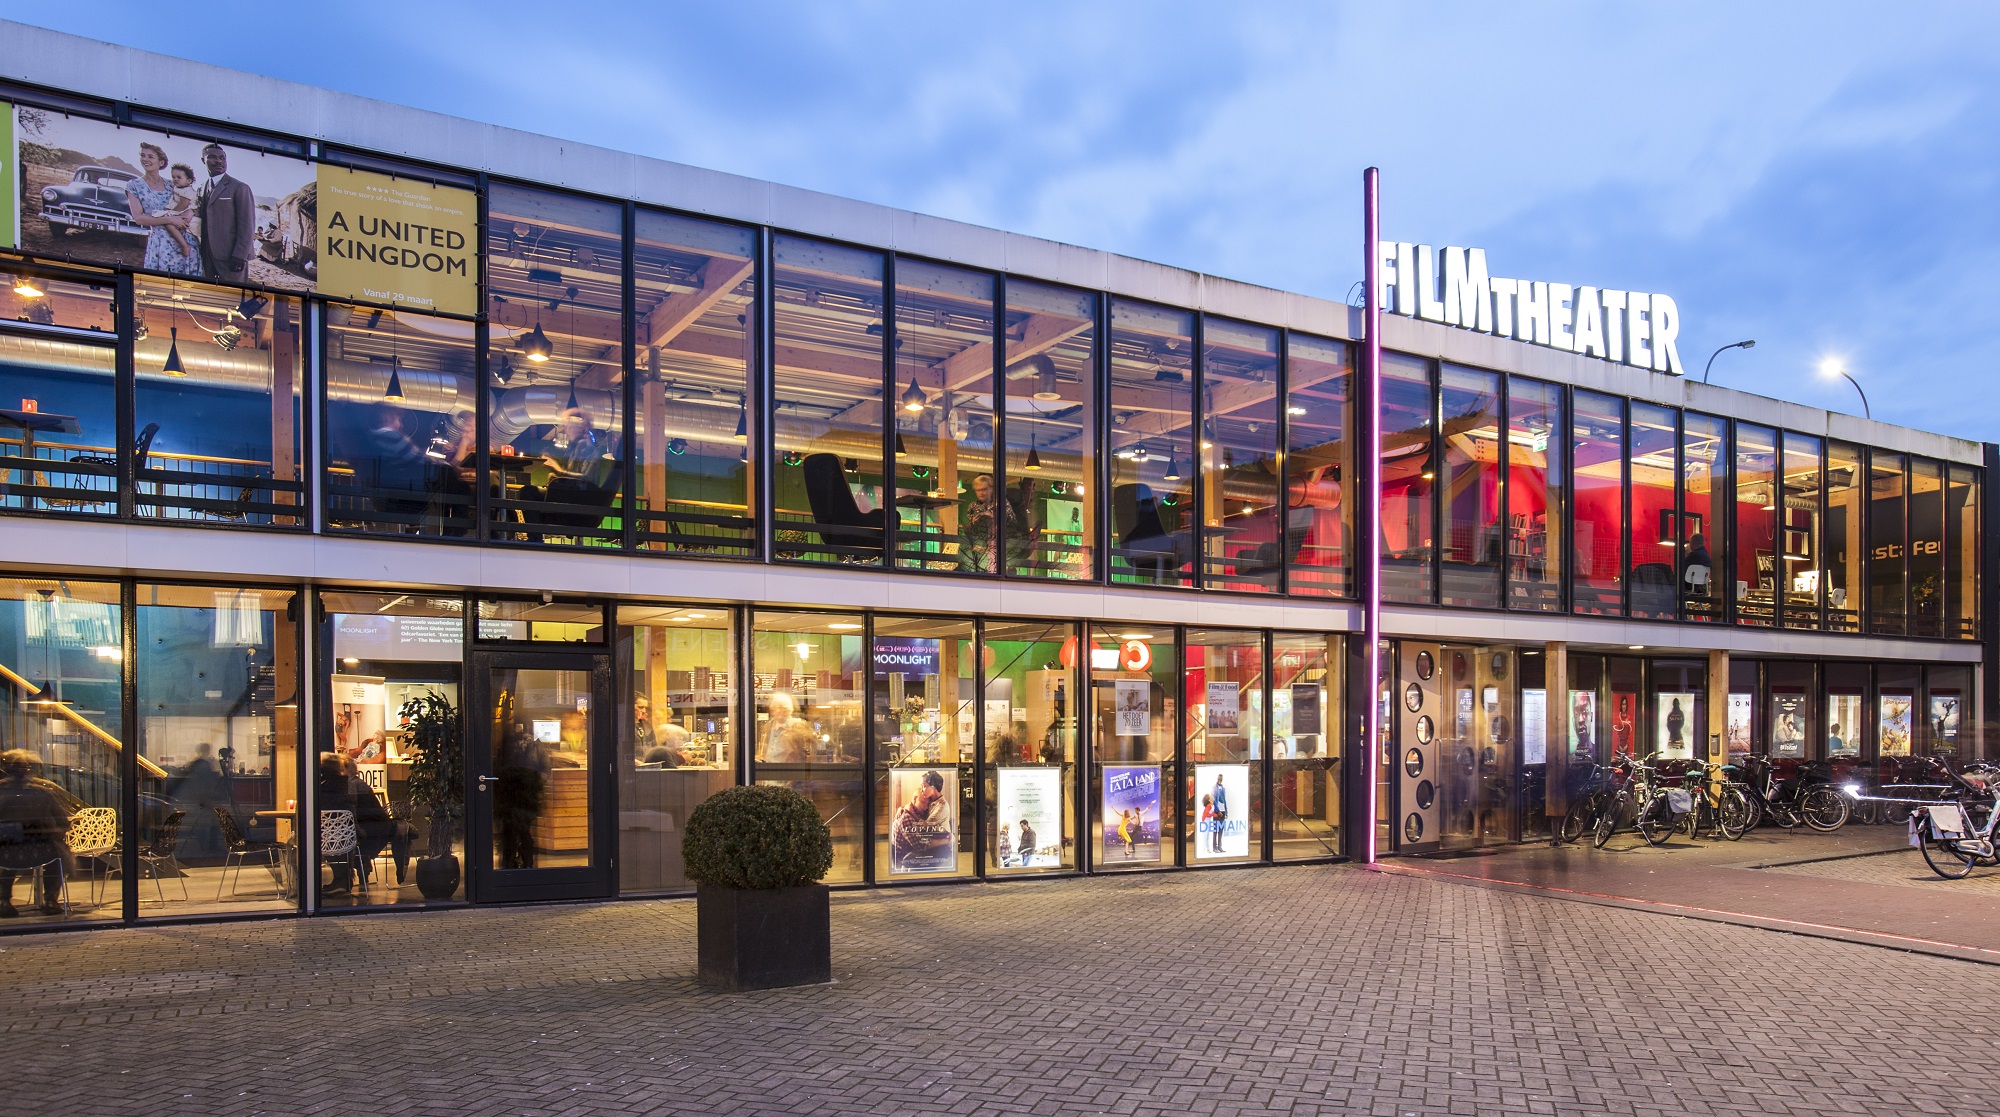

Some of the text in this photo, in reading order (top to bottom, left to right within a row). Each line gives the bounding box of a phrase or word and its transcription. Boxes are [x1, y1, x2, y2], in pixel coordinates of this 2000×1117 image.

[330, 186, 343, 194] The
[343, 188, 357, 196] true
[358, 190, 375, 200] story
[415, 202, 433, 210] shook
[443, 206, 465, 216] empire.
[391, 189, 431, 202] The Guardian
[328, 211, 465, 250] A UNITED
[328, 236, 467, 277] KINGDOM
[363, 287, 433, 306] Vanaf 29 maart
[1379, 241, 1684, 375] FILMTHEATER
[340, 627, 377, 635] MOONLIGHT
[873, 654, 932, 665] MOONLIGHT
[1110, 781, 1122, 793] LA
[1122, 778, 1134, 789] LA
[1135, 771, 1155, 786] LAND
[905, 825, 944, 833] LOVING
[1199, 820, 1247, 833] DEMAIN
